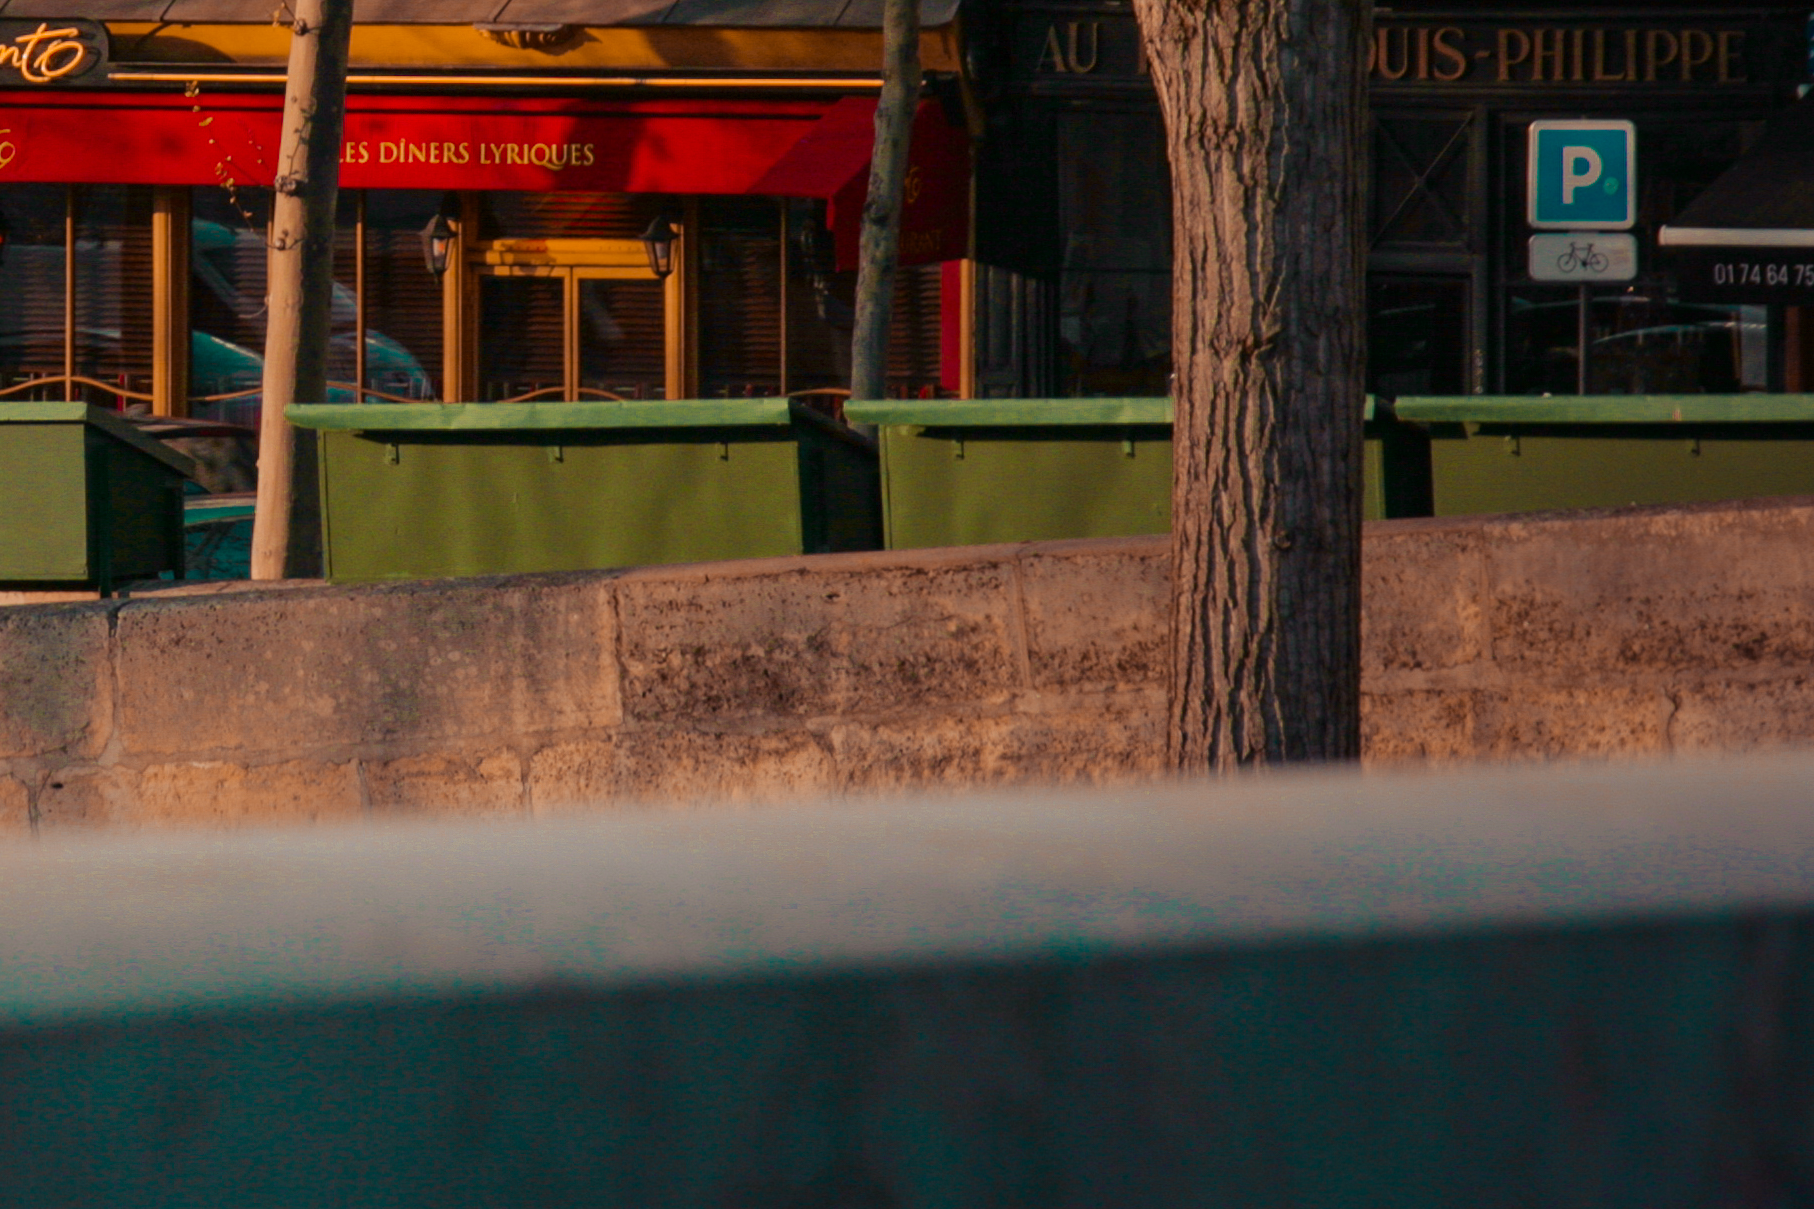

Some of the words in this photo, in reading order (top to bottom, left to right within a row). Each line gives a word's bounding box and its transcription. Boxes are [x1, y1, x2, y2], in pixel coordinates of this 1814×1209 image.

[1035, 22, 1098, 74] AU
[1367, 27, 1748, 83] UIS-PHILIPPE
[340, 141, 370, 164] ES
[480, 142, 595, 171] LYRIQUES
[1562, 146, 1602, 205] P
[1714, 263, 1734, 286] 01
[1739, 263, 1761, 286] 74
[1766, 263, 1788, 287] 64
